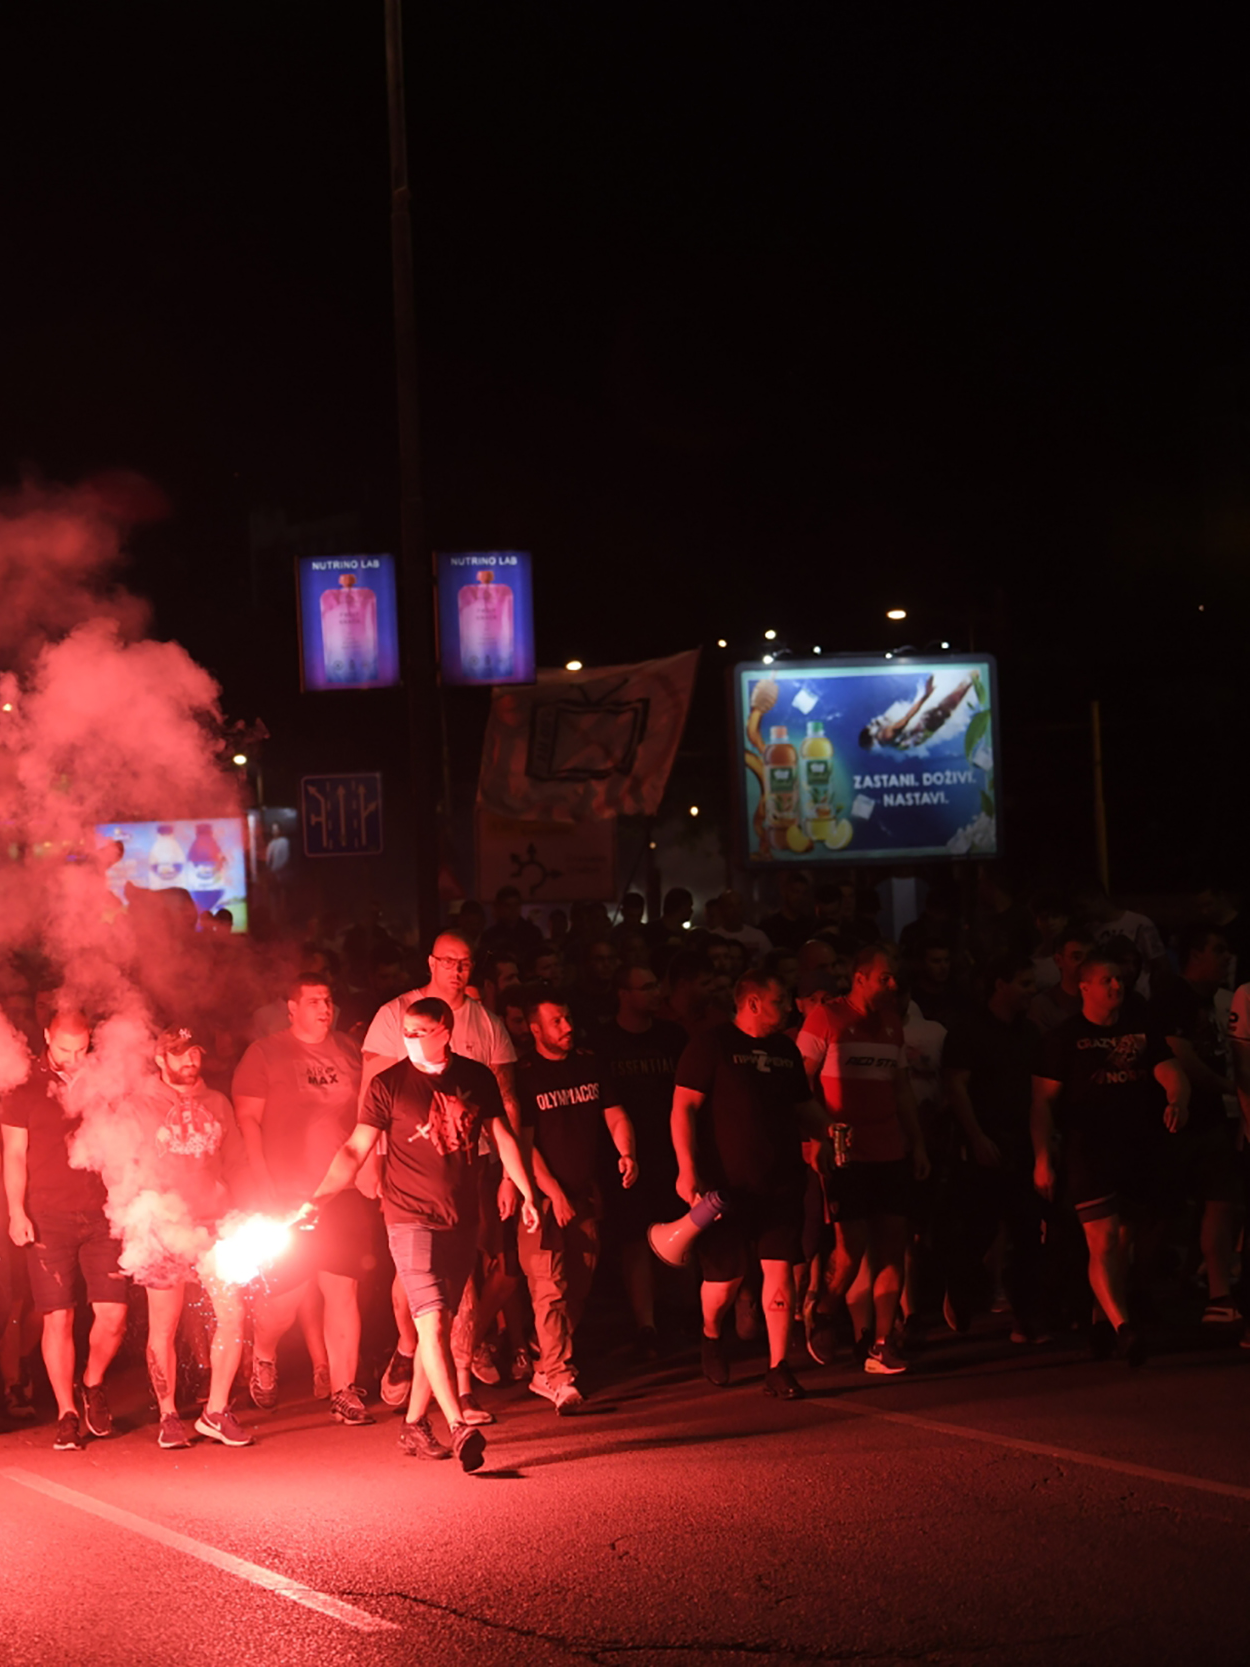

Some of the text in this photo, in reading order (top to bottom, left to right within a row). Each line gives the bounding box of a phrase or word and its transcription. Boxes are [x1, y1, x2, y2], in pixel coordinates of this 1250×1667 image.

[312, 559, 380, 571] NUTRINO LAB
[450, 555, 518, 566] NUTRINO LAB
[853, 769, 977, 789] ZASTANI. DOŽIVI.
[883, 791, 949, 807] NASTAVI.
[845, 1056, 875, 1066] RED
[308, 1074, 339, 1085] MAX
[536, 1082, 600, 1112] OLYMPIACOS
